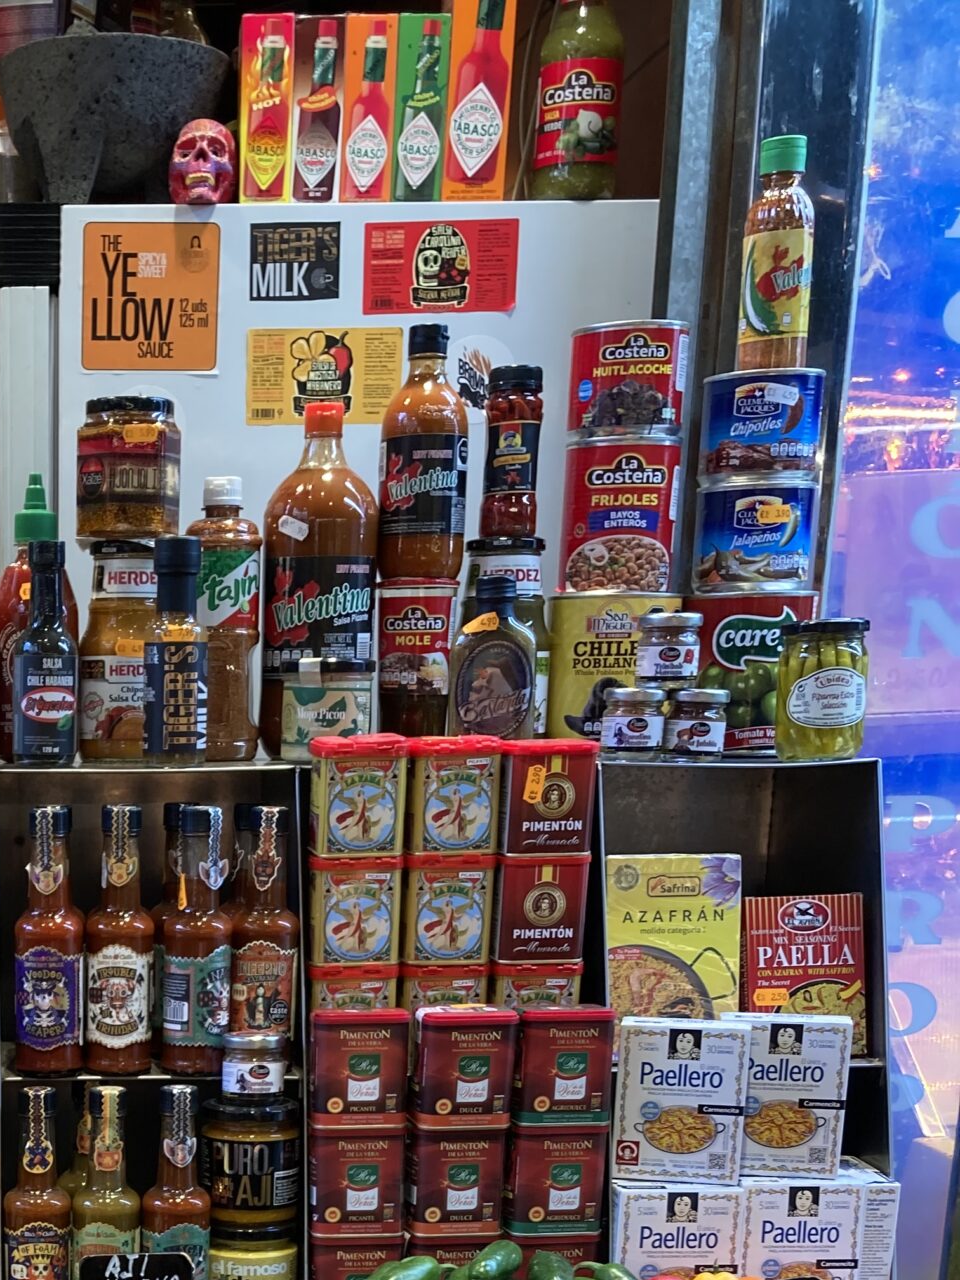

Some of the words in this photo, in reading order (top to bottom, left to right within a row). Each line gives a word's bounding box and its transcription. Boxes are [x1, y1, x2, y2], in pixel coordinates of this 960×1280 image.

[570, 73, 588, 86] La
[545, 84, 612, 105] Costeña
[252, 97, 281, 110] HOT
[453, 120, 500, 137] TABASCO
[101, 235, 121, 252] THE
[252, 226, 339, 262] TIGER'S
[100, 253, 138, 298] YE
[137, 265, 167, 278] SWEET
[252, 262, 309, 297] MILK
[180, 298, 189, 313] 12
[192, 298, 207, 312] uds
[92, 298, 174, 341] LLOW
[179, 313, 194, 328] 125
[197, 314, 209, 328] ml
[629, 334, 645, 347] La
[137, 341, 173, 358] SAUCE
[605, 344, 666, 360] Costeña
[593, 364, 673, 378] HUITLACOCHE
[730, 416, 783, 437] Chipotles
[621, 457, 639, 470] La
[591, 467, 664, 485] Costeña
[388, 467, 459, 503] Valentina
[591, 493, 658, 507] FRIJOLES
[610, 510, 640, 521] BAYOS
[603, 518, 647, 529] ENTEROS
[729, 529, 782, 550] Jalapeños
[107, 570, 158, 585] HERDE
[271, 584, 371, 632] Valentina
[408, 608, 421, 619] La
[605, 608, 628, 622] San
[386, 616, 442, 631] Costeña
[396, 635, 431, 647] MOLE
[573, 640, 639, 657] CHILE
[42, 658, 62, 670] SALSA
[27, 676, 43, 687] CHILE
[163, 646, 199, 750] TIGER'S
[296, 705, 316, 721] Mojo
[317, 706, 346, 721] Picón
[734, 728, 765, 739] Tomate
[522, 818, 582, 832] PIMENTÓN
[660, 881, 697, 894] Safrina
[622, 905, 725, 925] AZAFRÁN
[513, 925, 573, 939] PIMENTÓN
[640, 926, 665, 935] molido
[773, 936, 789, 945] MIX
[795, 934, 838, 944] SEASONING
[757, 943, 855, 968] PAELLA
[97, 967, 137, 980] TROUBLE
[757, 968, 772, 976] CON
[774, 968, 803, 976] AZAFRAN
[807, 967, 825, 976] WITH
[826, 966, 855, 976] SAFFRON
[640, 1061, 723, 1089] Paellero
[349, 1105, 376, 1113] PICANTE
[459, 1106, 483, 1114] DULCE
[702, 1105, 740, 1114] Carmencita
[803, 1100, 840, 1109] Carmencita
[213, 1143, 269, 1175] PURO
[639, 1225, 719, 1250] Paellero
[761, 1219, 840, 1244] Paellero
[212, 1262, 225, 1274] el
[227, 1261, 288, 1275] famoso
